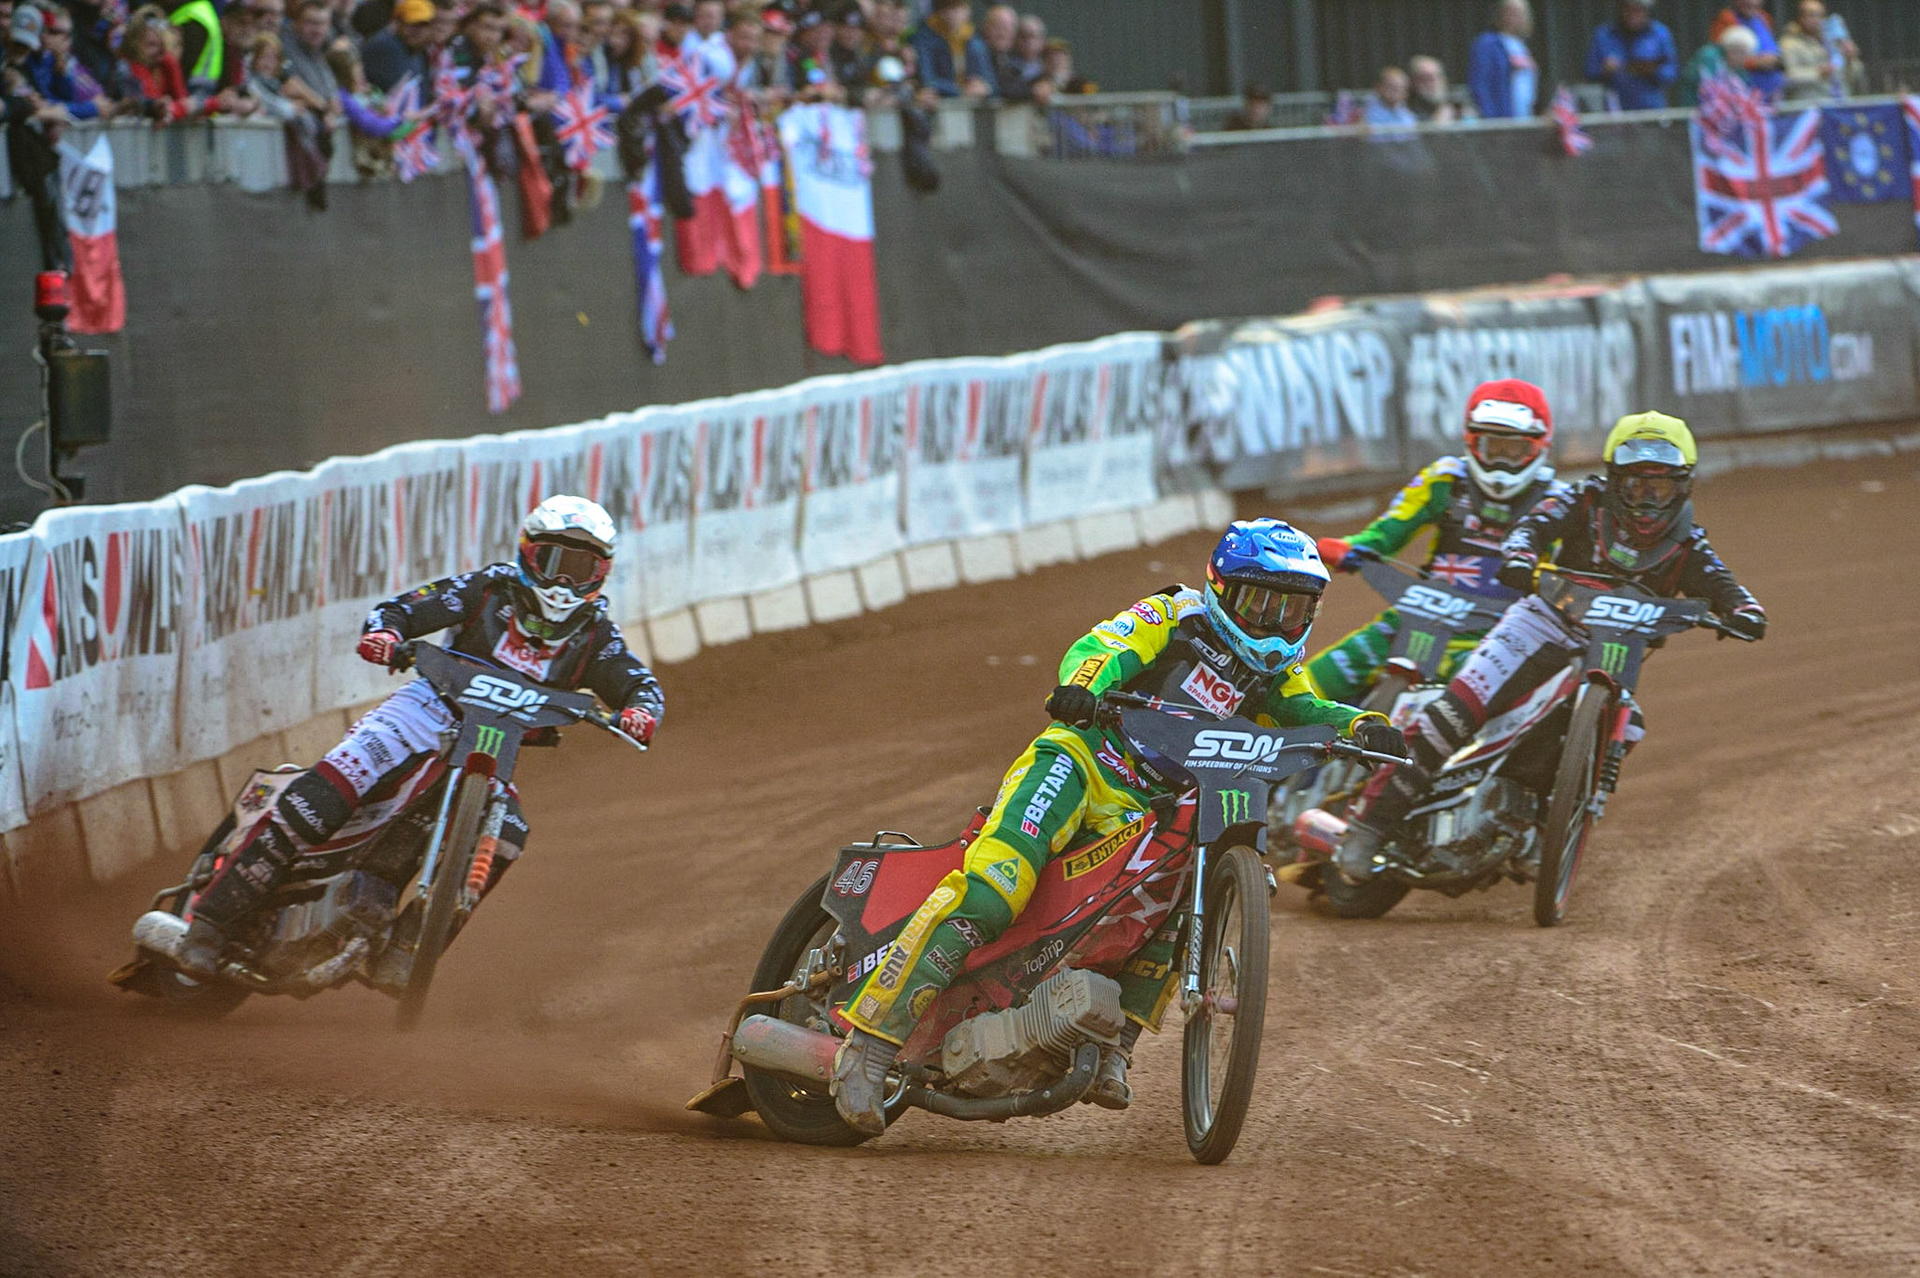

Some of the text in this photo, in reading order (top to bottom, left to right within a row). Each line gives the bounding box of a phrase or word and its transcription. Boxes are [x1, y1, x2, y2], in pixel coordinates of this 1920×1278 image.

[1187, 684, 1212, 707] SPARK
[1192, 667, 1243, 714] NGK
[1188, 729, 1285, 763] SDN
[1197, 760, 1234, 770] SPEEDWAY
[1233, 761, 1243, 770] OF
[833, 858, 880, 896] 46
[1022, 938, 1065, 975] TapTrip
